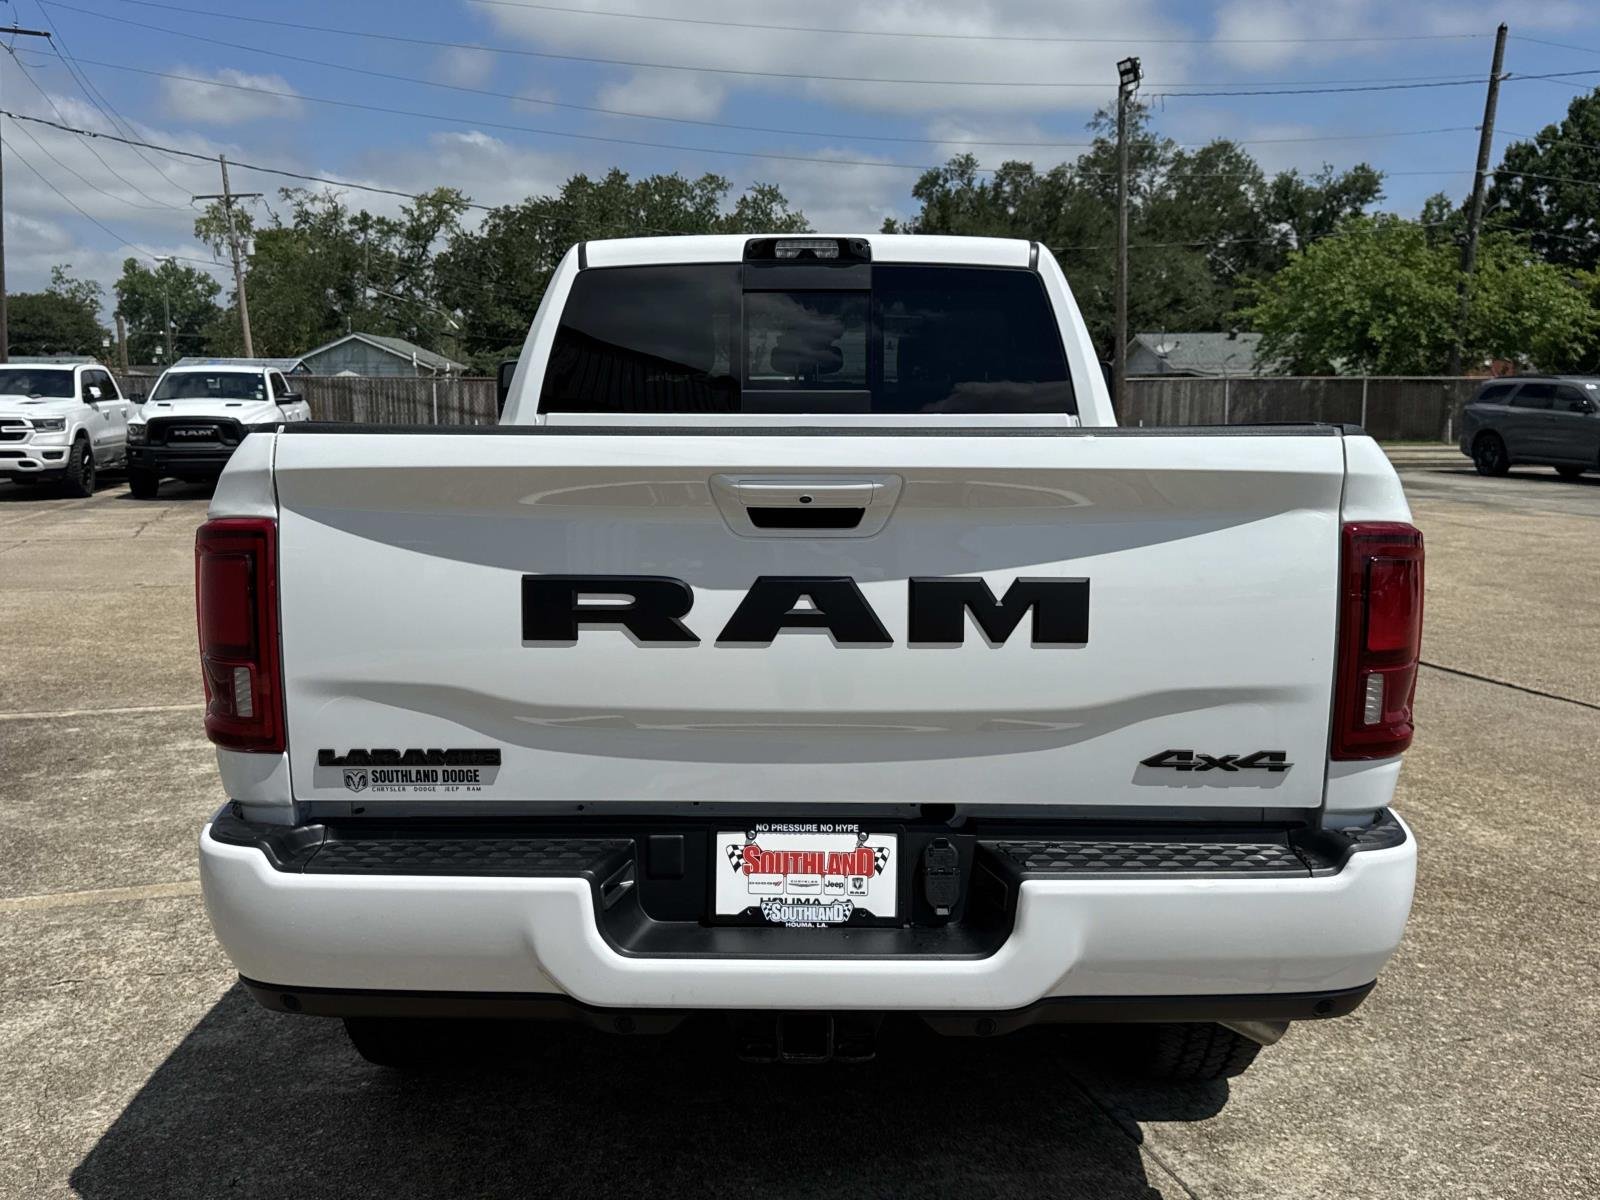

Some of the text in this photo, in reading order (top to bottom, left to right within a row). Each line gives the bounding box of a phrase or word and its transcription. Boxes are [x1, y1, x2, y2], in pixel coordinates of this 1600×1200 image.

[522, 574, 1091, 643] RAM
[1139, 749, 1295, 772] 4x4
[371, 769, 480, 784] SOUTHLAND DODGE
[755, 823, 859, 833] NO PRESSURE NO HYPE
[742, 845, 875, 878] SOUTHLAND
[825, 880, 844, 889] Jeep
[771, 902, 844, 922] SOUTHLAND
